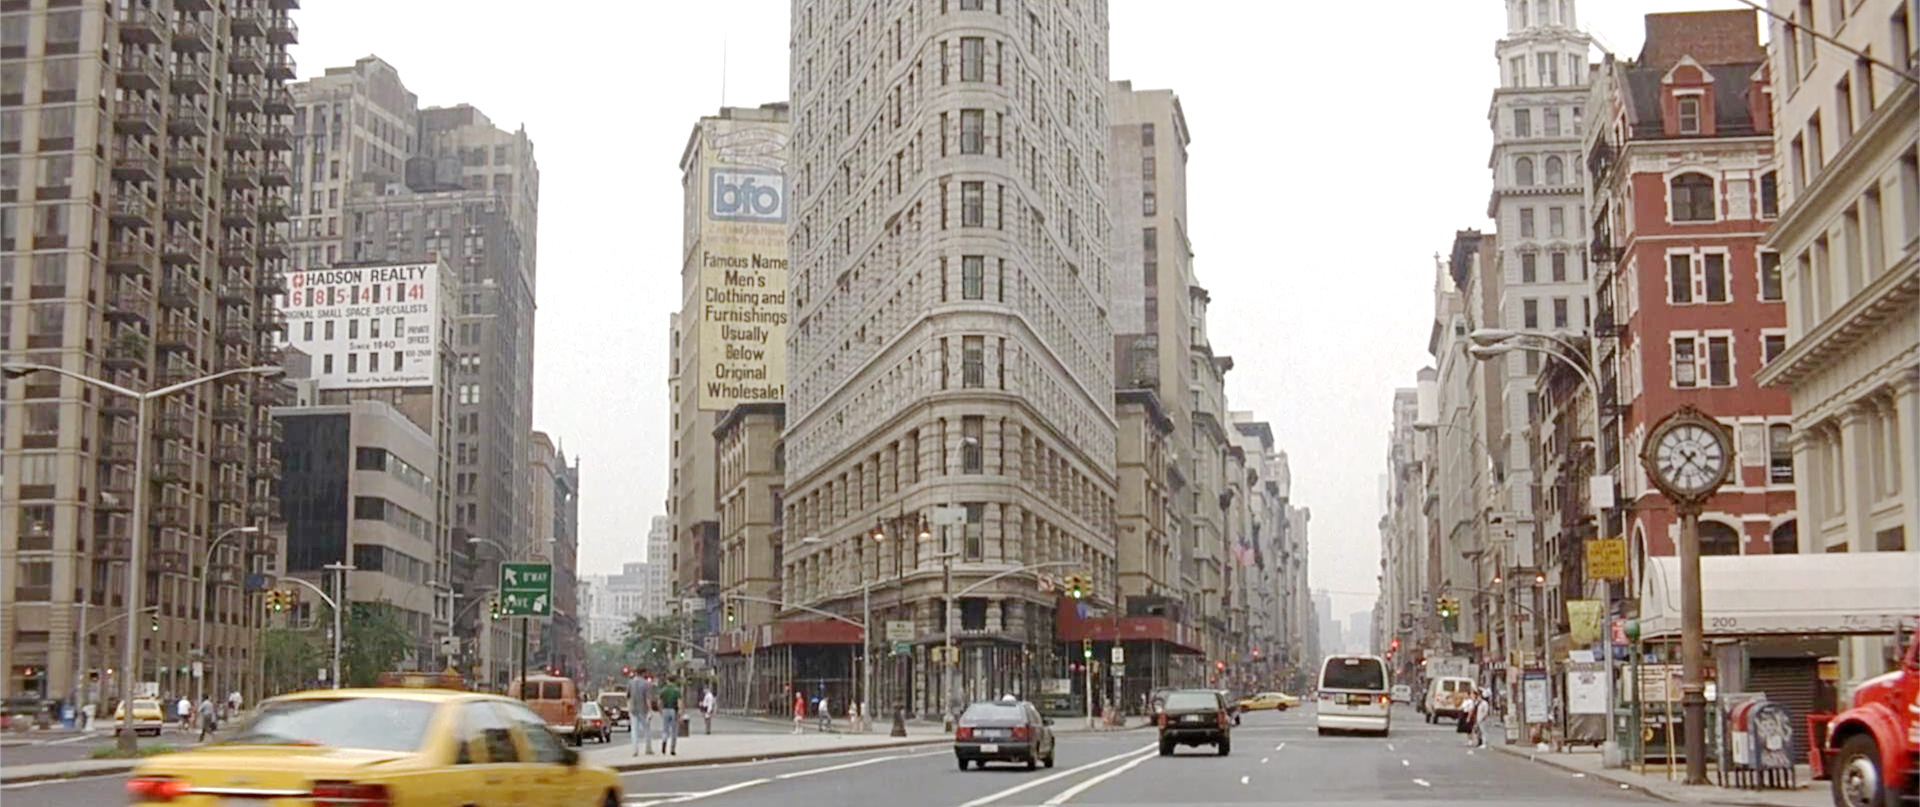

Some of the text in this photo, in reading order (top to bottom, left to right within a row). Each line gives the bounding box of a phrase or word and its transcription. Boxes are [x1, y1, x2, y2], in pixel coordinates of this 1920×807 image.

[716, 175, 780, 215] bfo
[703, 251, 789, 270] Famous Name
[306, 266, 427, 286] HADSON REALTY
[724, 269, 766, 288] Men's
[705, 287, 785, 306] Clothing and
[317, 308, 342, 319] SMALL
[345, 307, 371, 317] SPACE
[375, 304, 428, 316] SPECIALISTS
[705, 305, 788, 327] Furnishings
[721, 324, 769, 345] Usually
[726, 344, 765, 361] Below
[715, 363, 767, 381] Original
[707, 382, 784, 400] Wholesale!
[1712, 617, 1737, 627] 200
